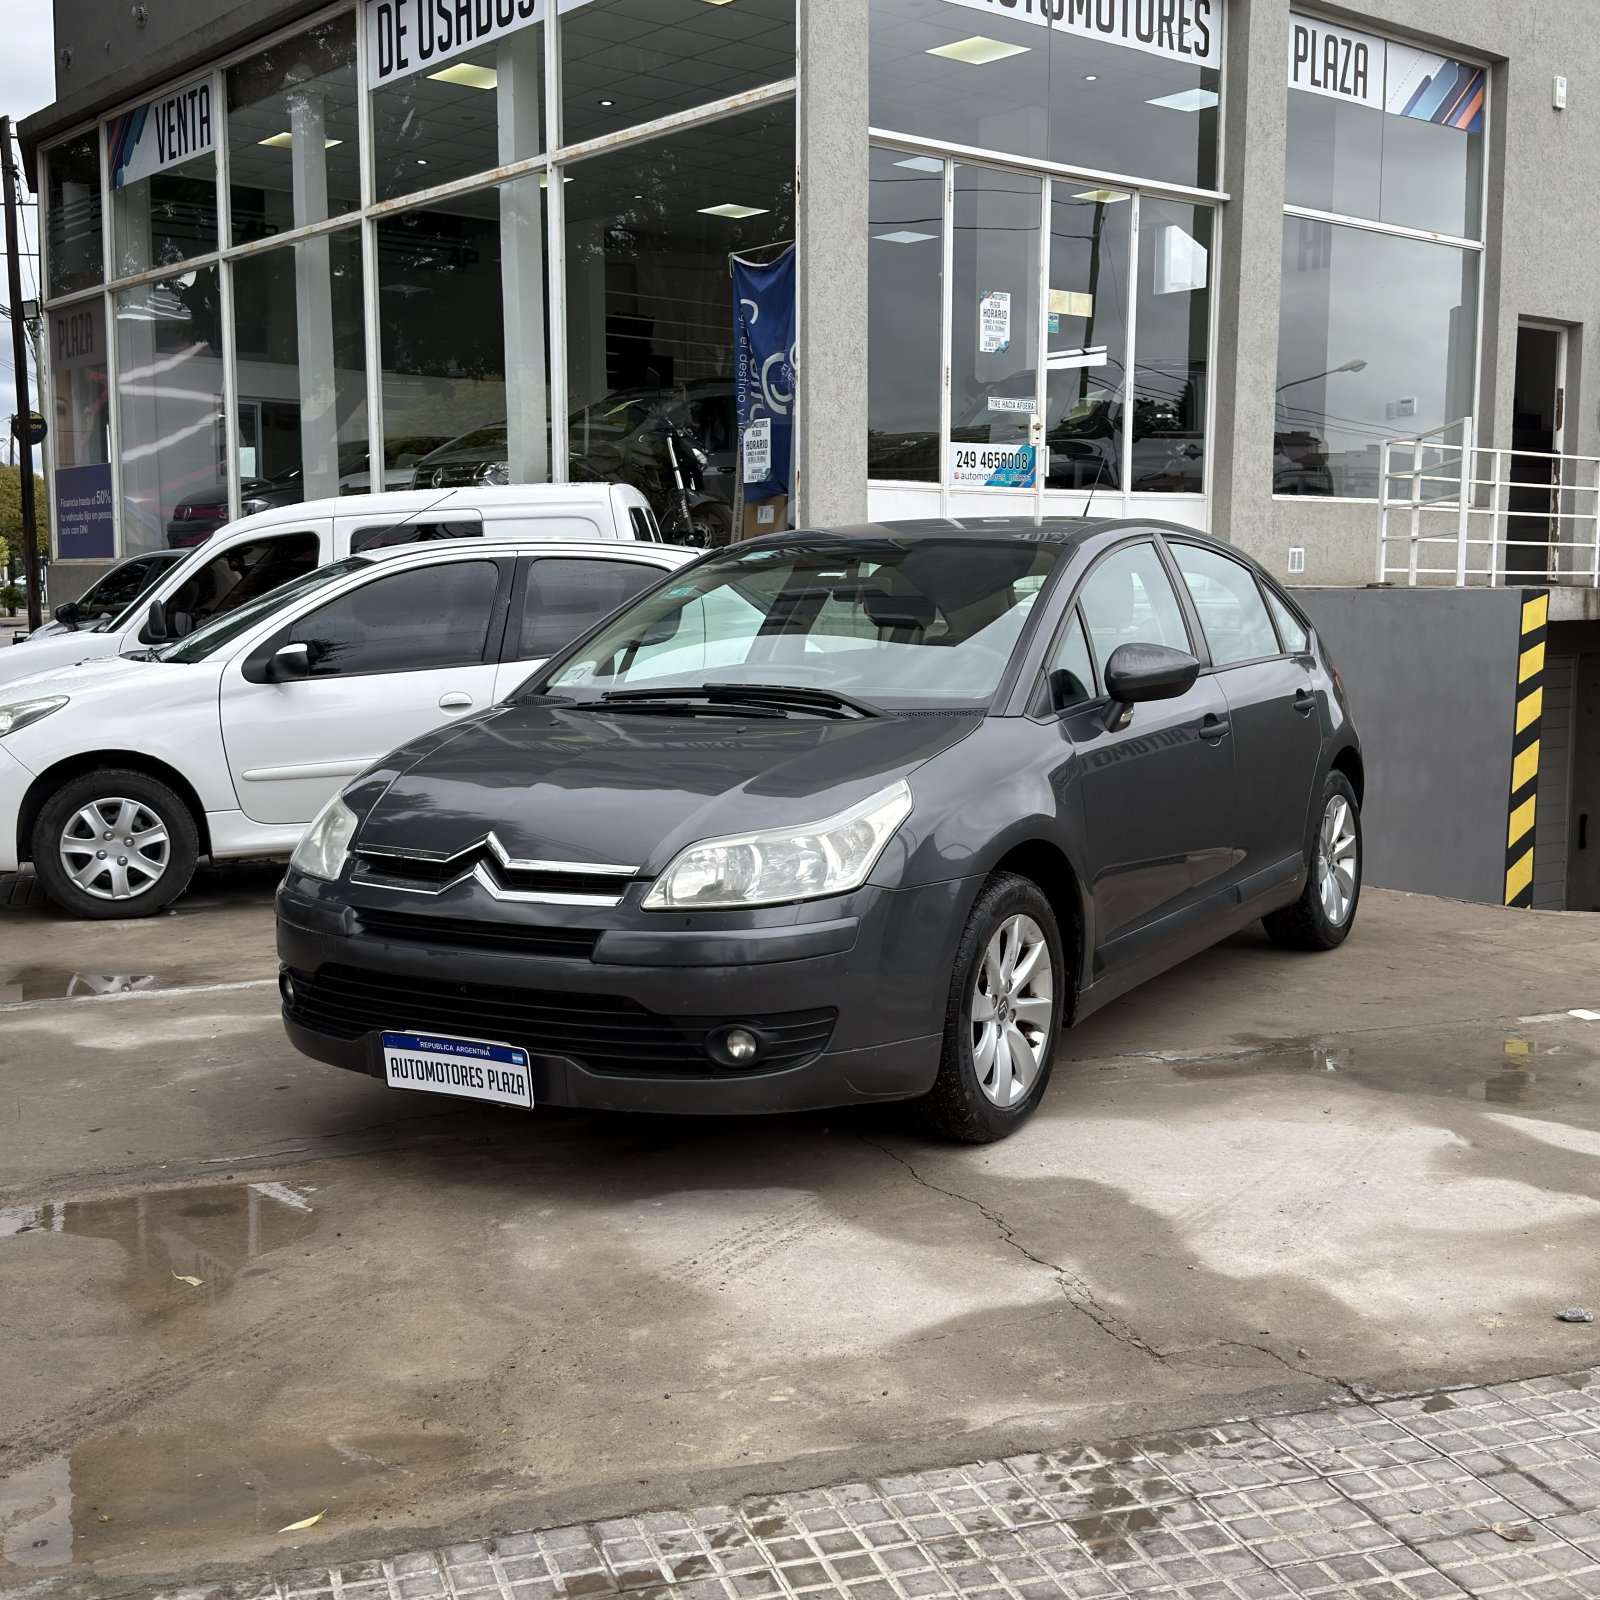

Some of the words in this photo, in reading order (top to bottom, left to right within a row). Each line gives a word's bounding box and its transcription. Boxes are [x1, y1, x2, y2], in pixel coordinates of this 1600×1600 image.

[377, 0, 408, 78] DE
[417, 0, 535, 61] USAD
[985, 0, 1211, 58] OTORES
[1293, 24, 1369, 99] PLAZA
[155, 84, 211, 164] VENTA
[983, 309, 1007, 319] HORARIO
[58, 312, 93, 360] PLAZA
[738, 354, 748, 403] destino
[990, 399, 1001, 409] TIRE
[1002, 400, 1015, 409] HACIA
[1017, 402, 1034, 410] AFUERA
[746, 440, 768, 450] HORARIO
[956, 450, 976, 469] 249
[980, 452, 1028, 470] 4658008
[96, 489, 112, 505] 50%
[420, 1041, 454, 1052] REPUBLICA
[456, 1046, 490, 1056] ARGENTINA
[390, 1057, 484, 1089] AUTOMOTORES
[487, 1069, 525, 1096] PLAZA
